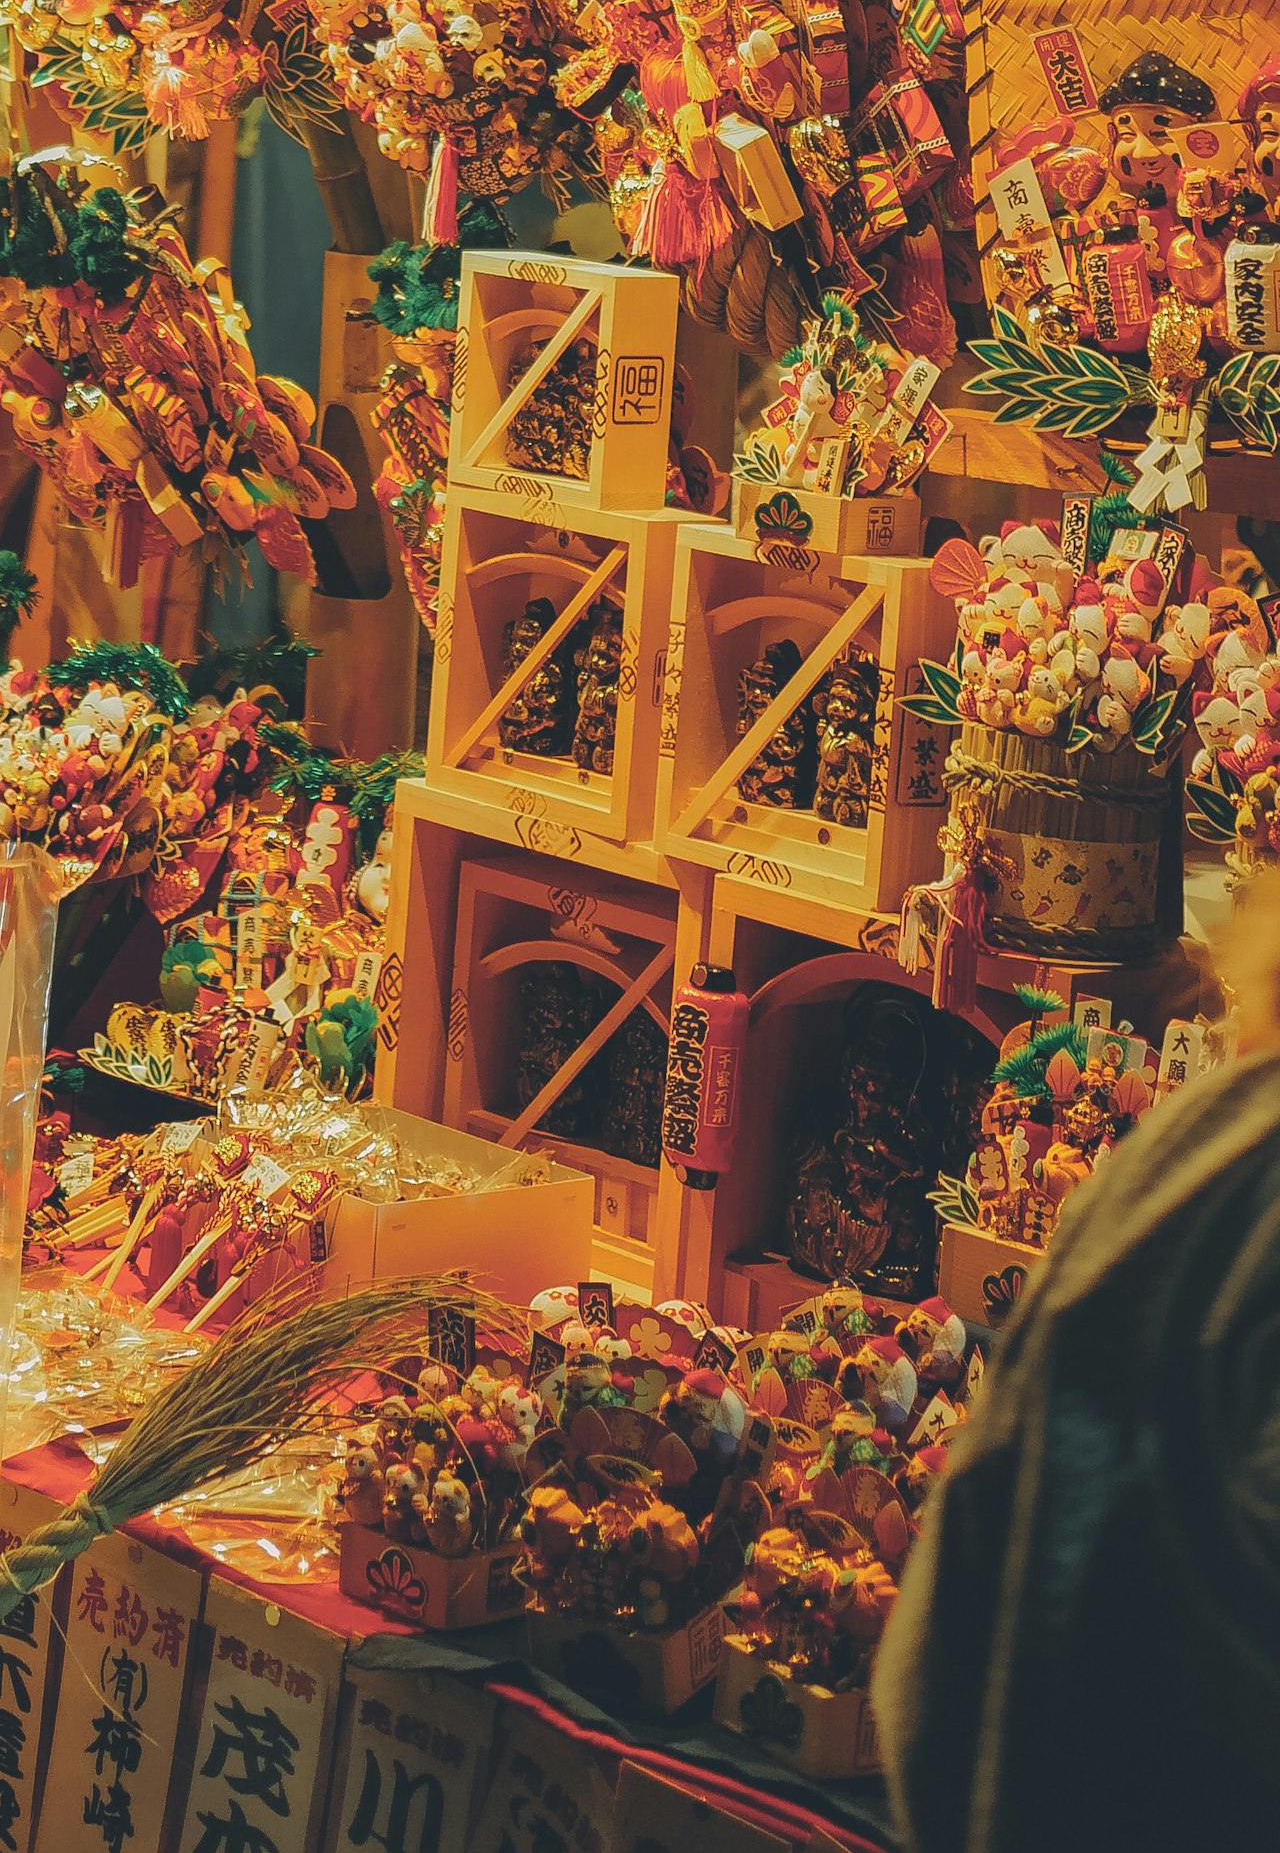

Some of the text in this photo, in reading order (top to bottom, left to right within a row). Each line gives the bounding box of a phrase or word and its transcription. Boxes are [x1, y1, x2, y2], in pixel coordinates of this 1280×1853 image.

[1047, 49, 1088, 111] 大吉
[1231, 257, 1266, 347] 家内安全
[620, 365, 657, 417] 福
[907, 675, 941, 802] 繁盛
[76, 1567, 186, 1668] 売約済
